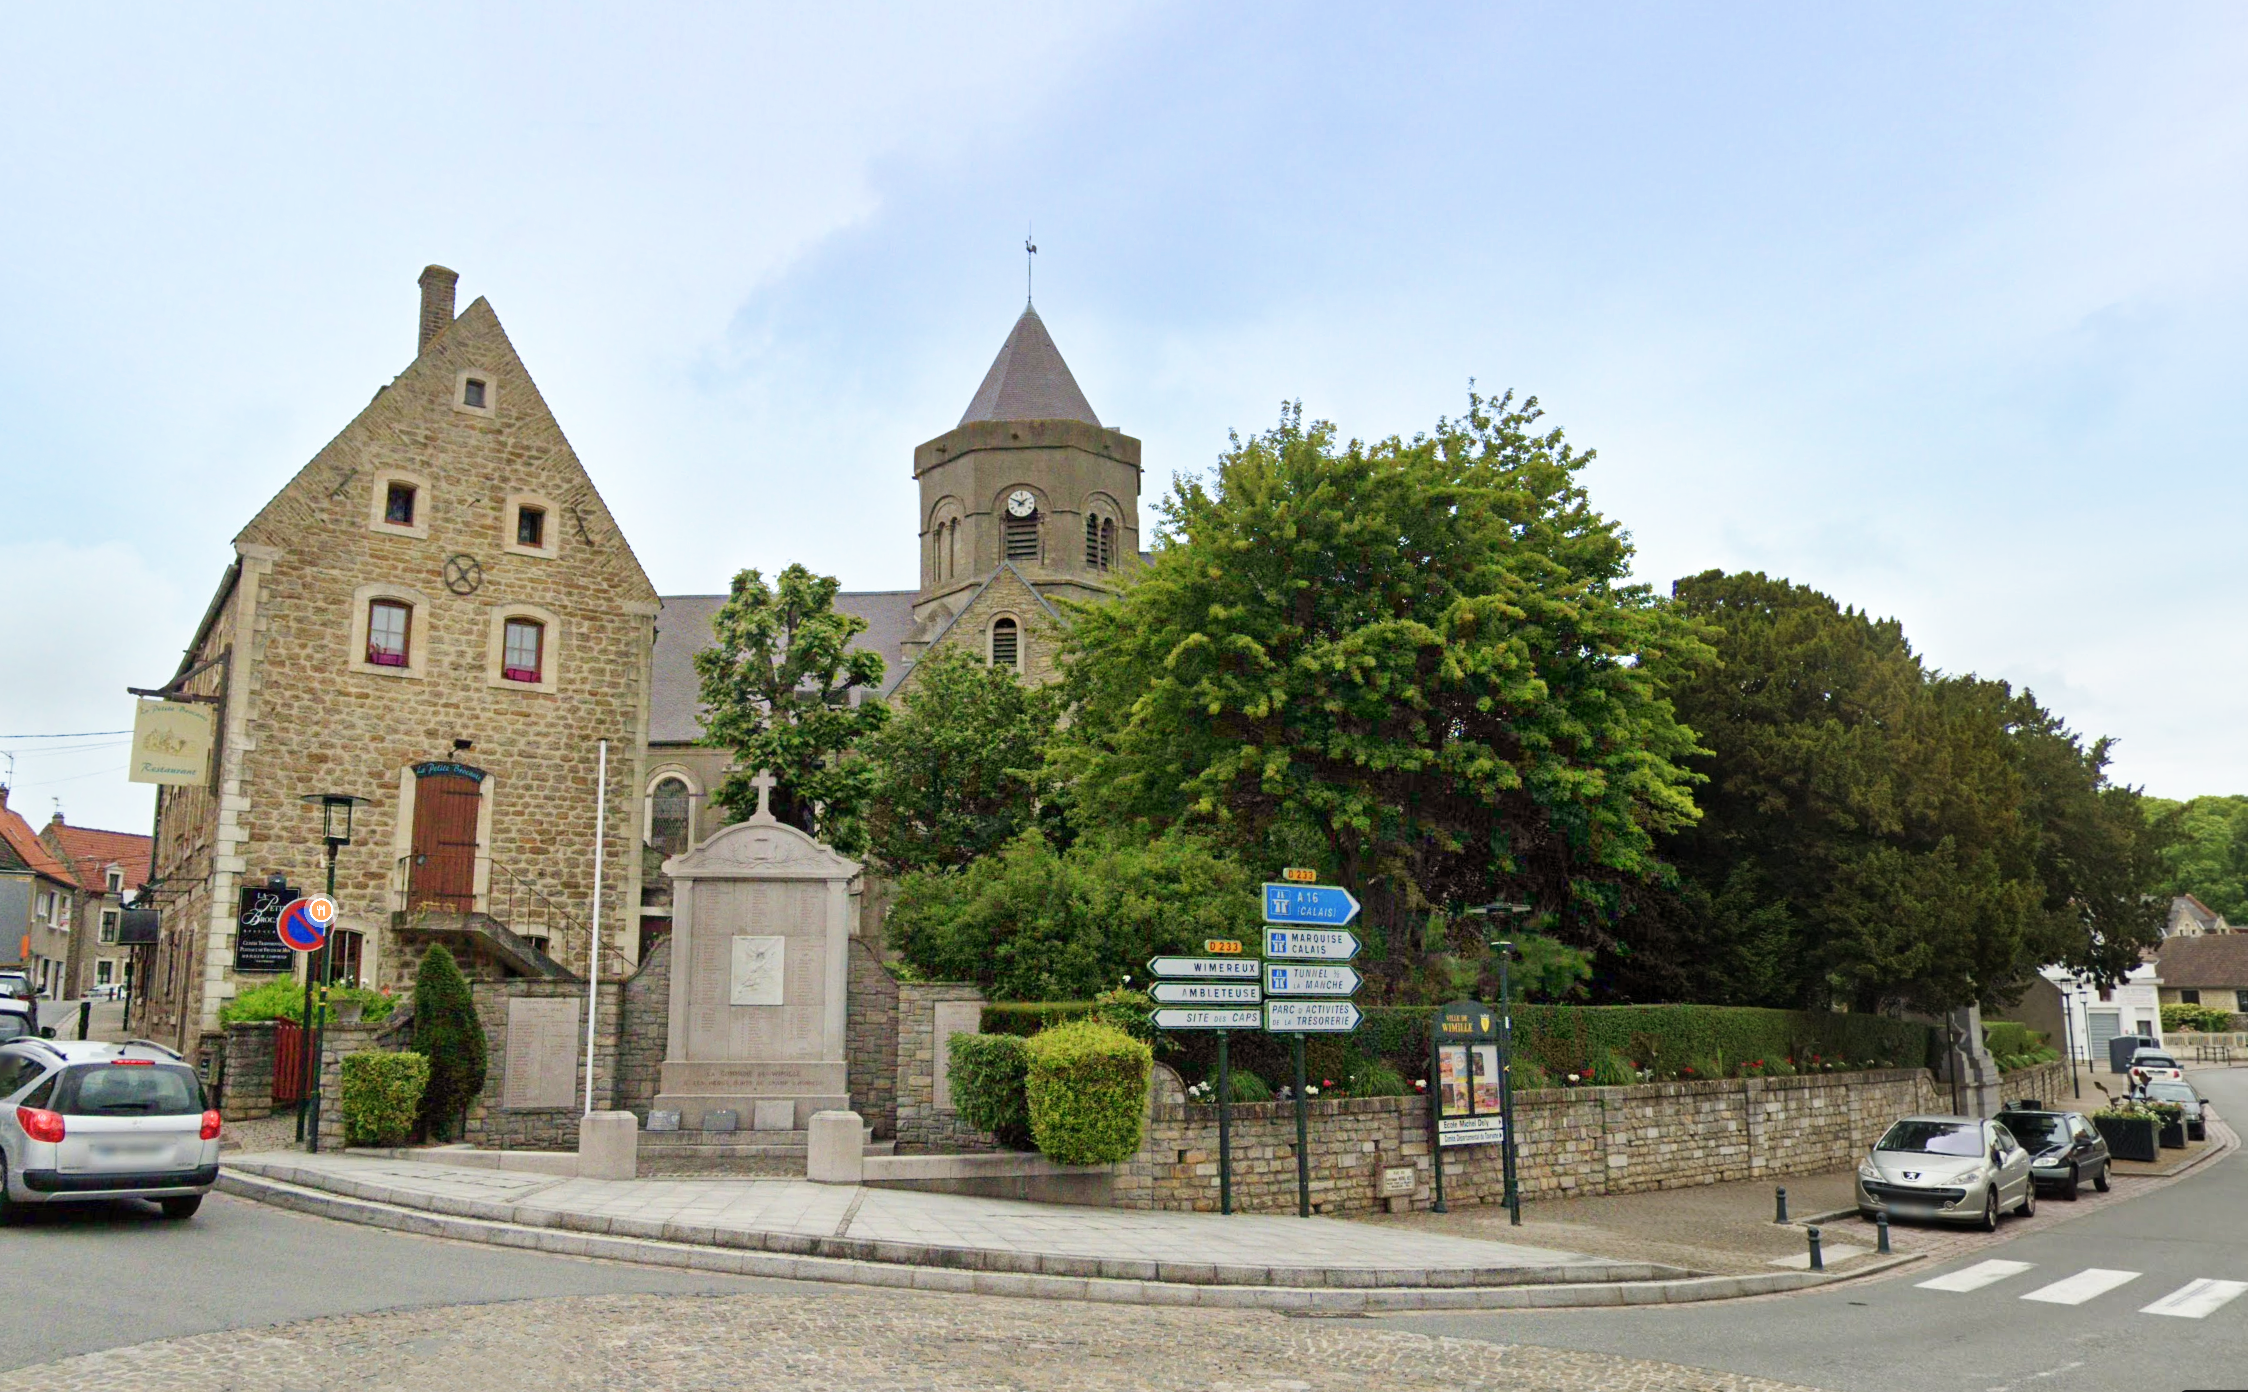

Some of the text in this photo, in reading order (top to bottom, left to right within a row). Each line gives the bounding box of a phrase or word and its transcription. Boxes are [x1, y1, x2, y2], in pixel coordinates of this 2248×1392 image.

[141, 762, 198, 776] Restaurant
[1288, 870, 1314, 880] D 233
[1297, 892, 1319, 903] A 16
[1297, 906, 1336, 917] (CALAIS)
[1291, 933, 1343, 944] MARQUISE
[1209, 942, 1239, 951] D 233
[1291, 945, 1327, 955] CALAIS
[1194, 963, 1255, 973] WIMEREUX
[1293, 968, 1328, 979] TUNNEL
[1305, 980, 1344, 990] MANCHE
[1182, 988, 1256, 998] AMBLETEUSE
[1272, 1004, 1296, 1014] PARC
[1186, 1013, 1209, 1023] SITE
[1232, 1012, 1258, 1023] CAPS
[1442, 1022, 1473, 1033] WIMILLE
